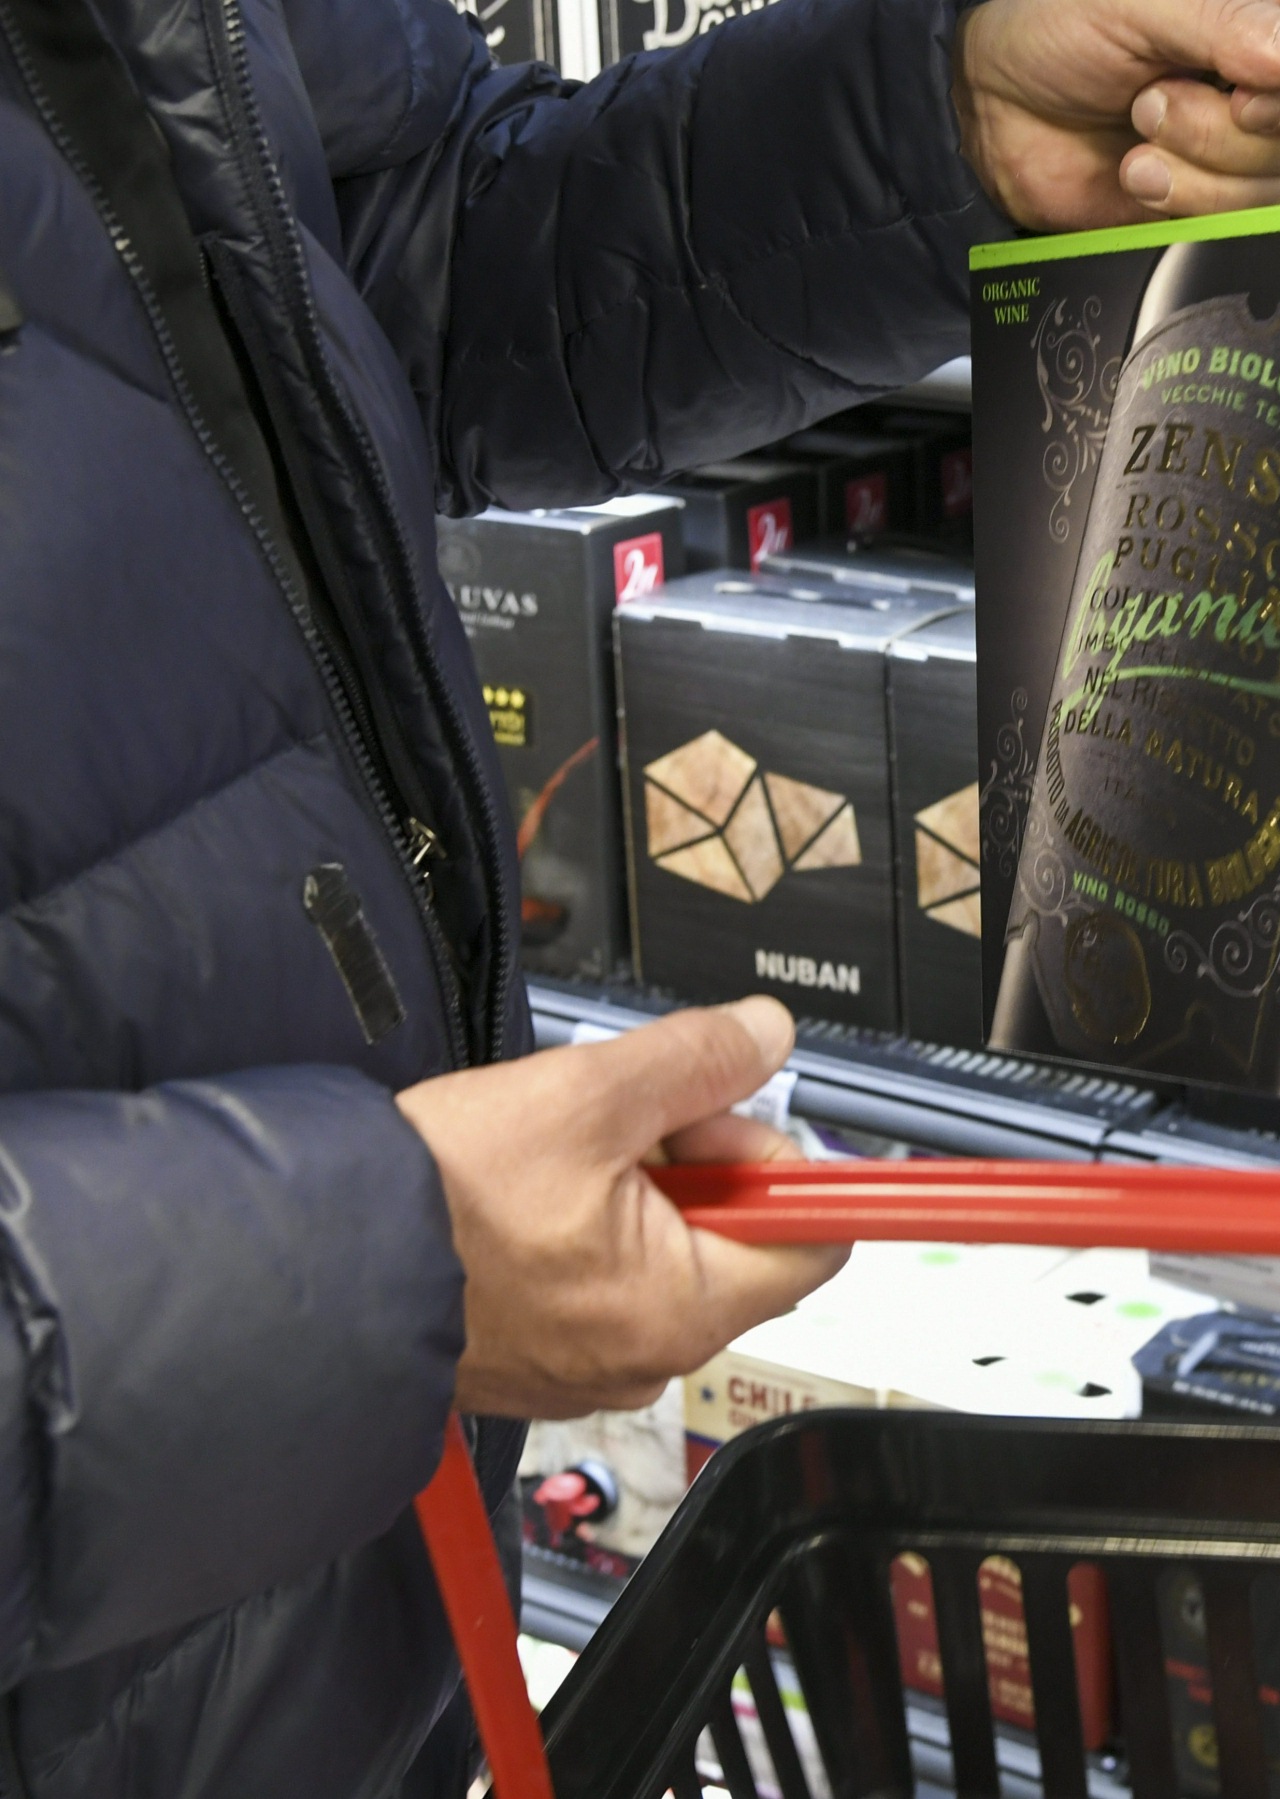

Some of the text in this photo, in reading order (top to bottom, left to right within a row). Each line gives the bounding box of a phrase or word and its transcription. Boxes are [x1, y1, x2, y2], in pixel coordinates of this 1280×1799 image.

[982, 276, 1041, 301] ORGANIC
[994, 303, 1030, 325] WINE
[1141, 346, 1201, 390] VINO
[1160, 383, 1247, 412] VECCHIE
[459, 585, 539, 617] UVAS
[1063, 708, 1259, 825] DELLA NATURA
[1072, 870, 1109, 902] VINO
[756, 950, 861, 995] NUBAN
